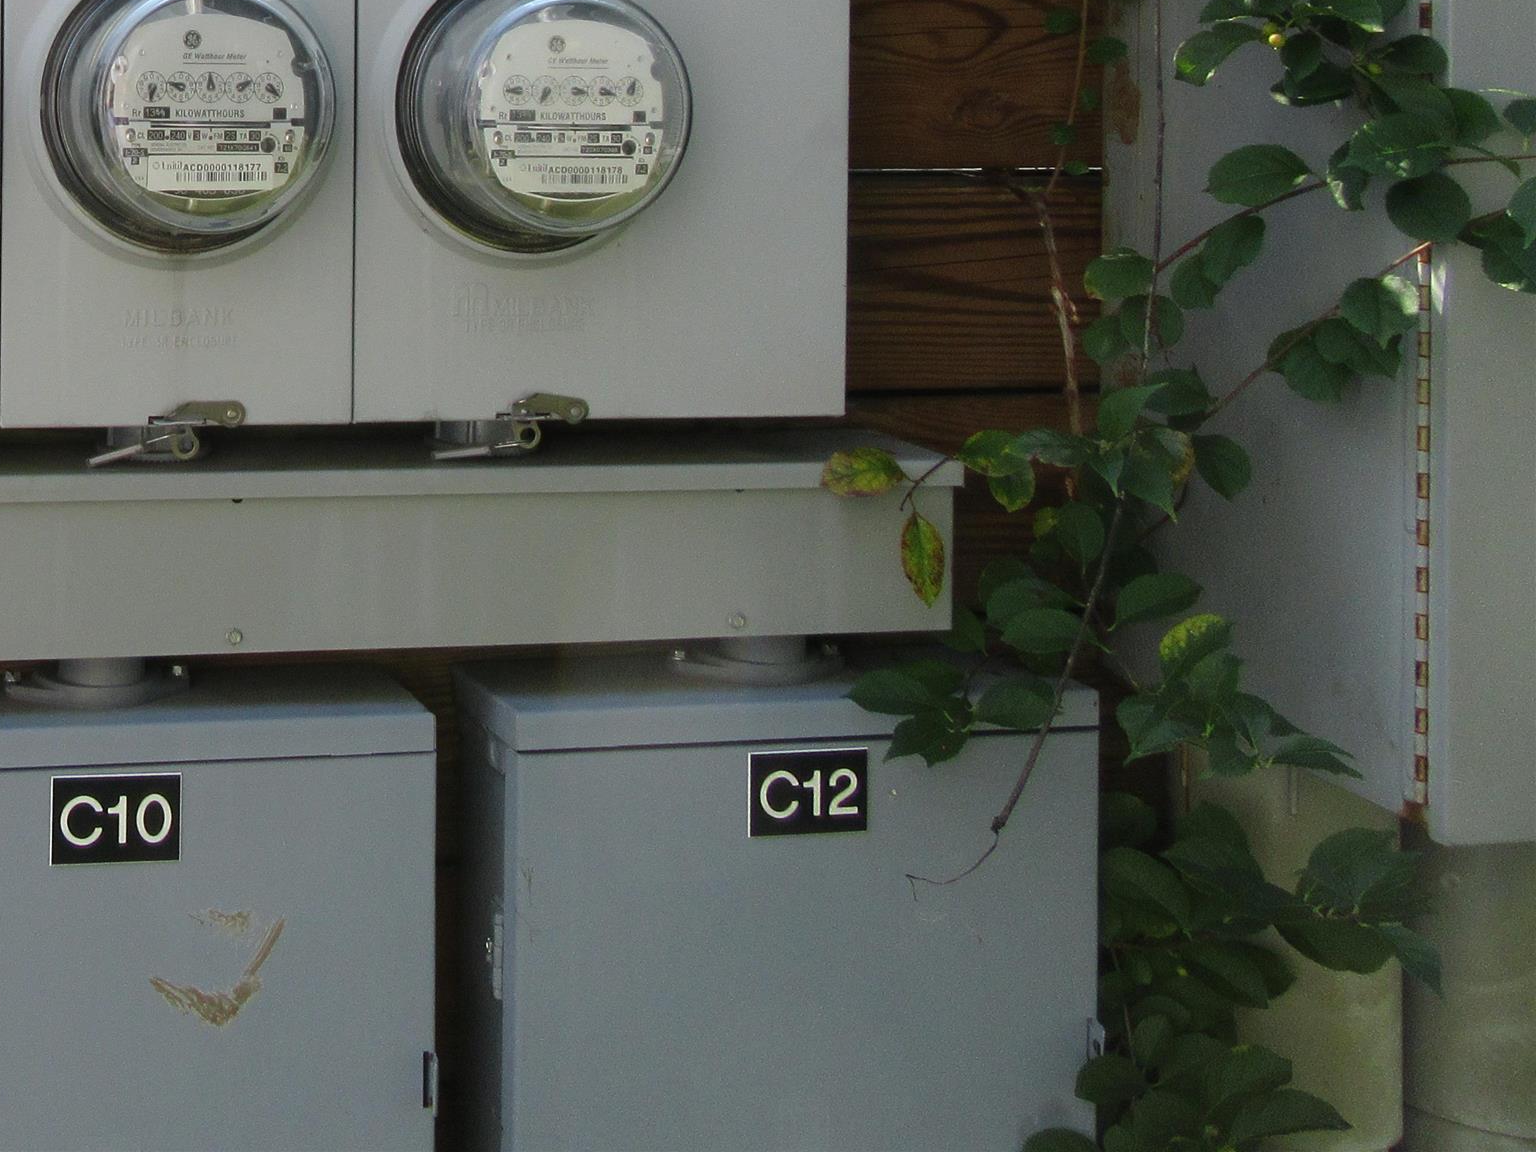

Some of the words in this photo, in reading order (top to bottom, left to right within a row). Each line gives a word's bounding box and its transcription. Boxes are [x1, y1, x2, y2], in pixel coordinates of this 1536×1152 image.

[175, 109, 245, 118] KILOWATTHOURS
[540, 112, 606, 120] KILOWATTHOURS
[148, 131, 163, 139] 200
[170, 131, 185, 139] 240
[183, 163, 261, 171] ACD0000118177
[548, 166, 622, 174] ACD0000118178
[124, 308, 234, 329] MILBANK
[759, 768, 859, 819] C12
[60, 793, 172, 846] C10
